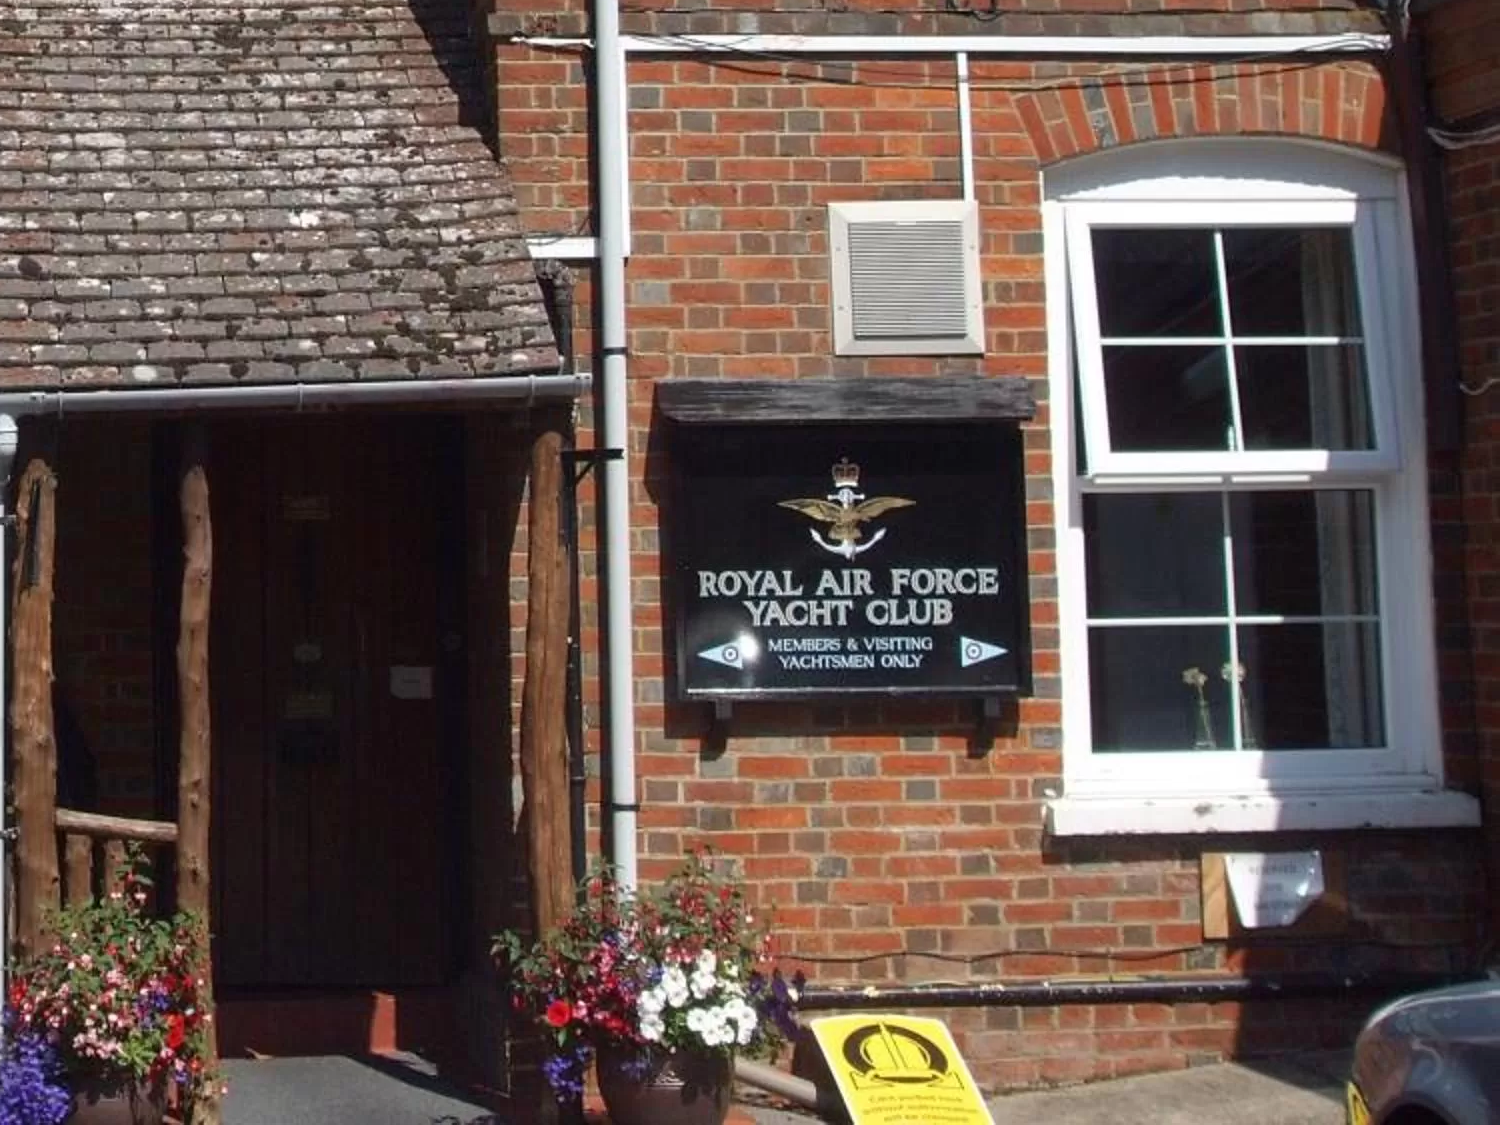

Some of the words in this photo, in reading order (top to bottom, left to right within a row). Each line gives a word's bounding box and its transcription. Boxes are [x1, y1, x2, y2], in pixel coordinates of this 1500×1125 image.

[698, 570, 804, 597] ROYAL
[815, 568, 874, 596] AIR
[890, 568, 999, 595] FORCE
[742, 600, 853, 627] YACHT
[865, 599, 953, 626] CLUB
[768, 638, 841, 652] MEMBERS
[846, 638, 858, 652] &
[863, 637, 933, 651] VISITING
[778, 655, 875, 669] YACHTSMEN
[880, 654, 924, 668] ONLY
